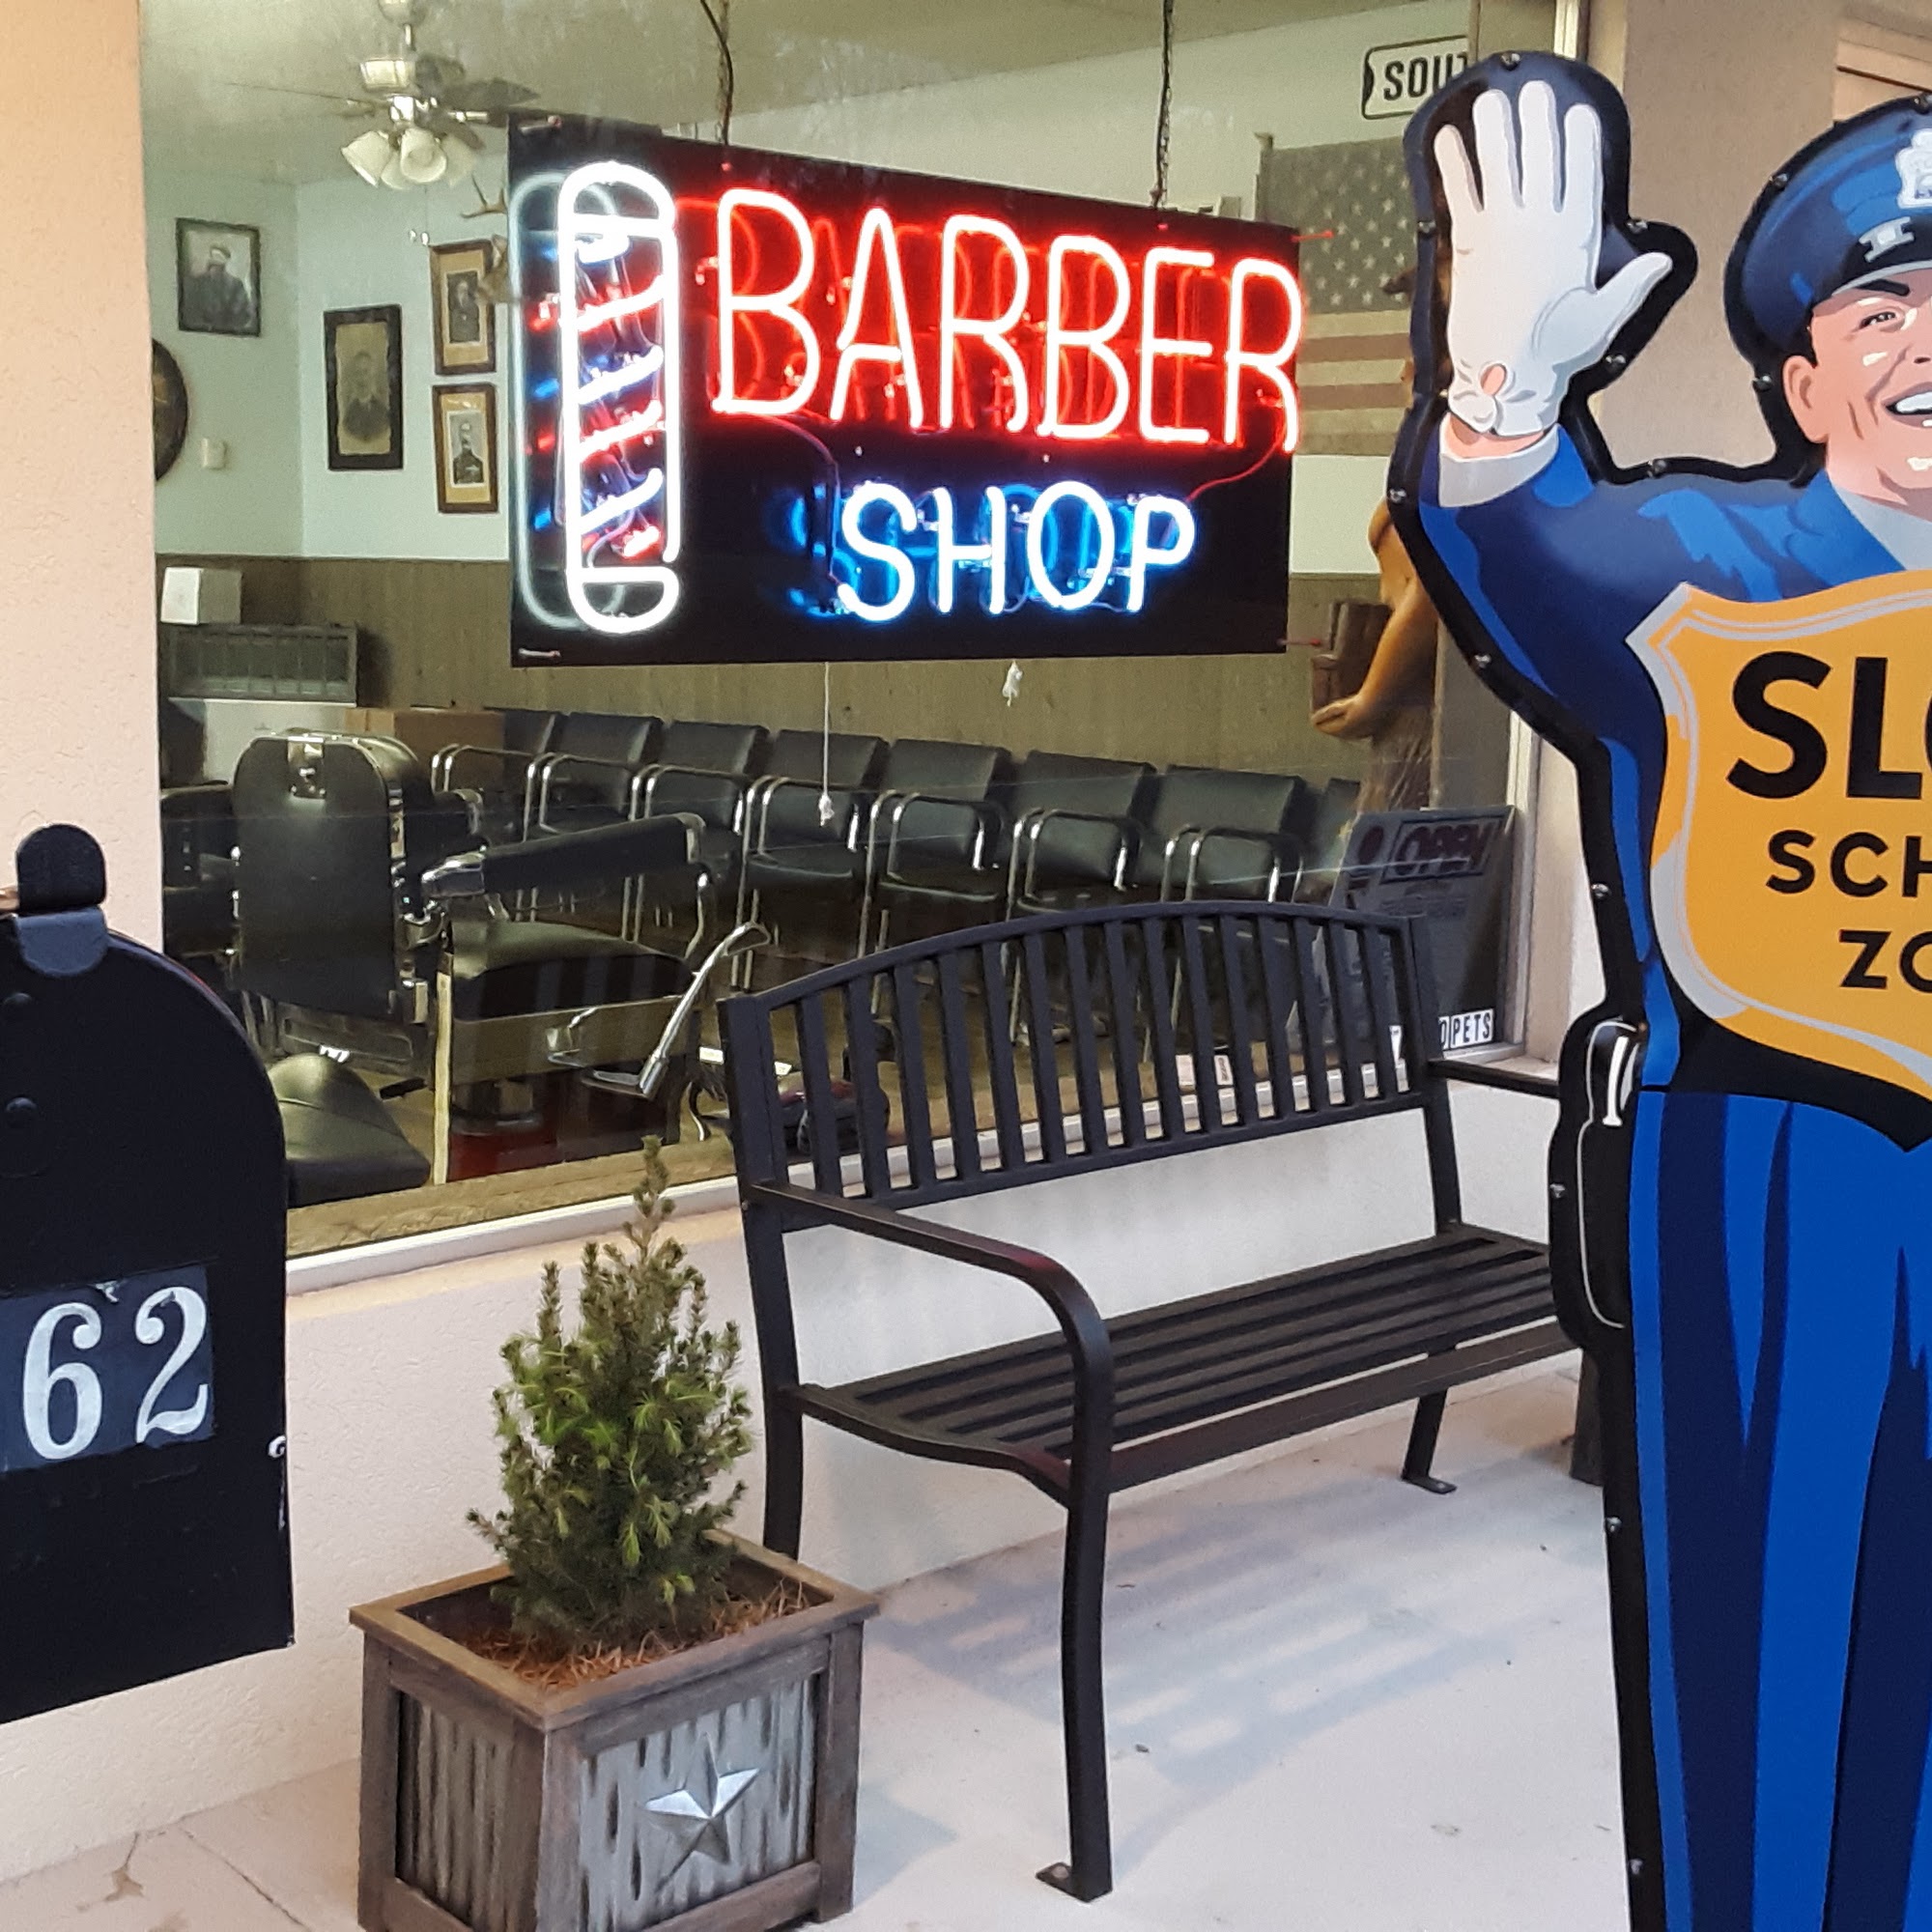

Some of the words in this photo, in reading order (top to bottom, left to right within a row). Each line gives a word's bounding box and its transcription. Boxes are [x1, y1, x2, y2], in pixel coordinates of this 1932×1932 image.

[1383, 51, 1467, 100] SOU
[711, 187, 1303, 452] BARBER
[836, 479, 1197, 622] SHOP
[1725, 650, 1932, 800] SL
[1452, 1011, 1492, 1045] PETS
[23, 1286, 209, 1460] 62
